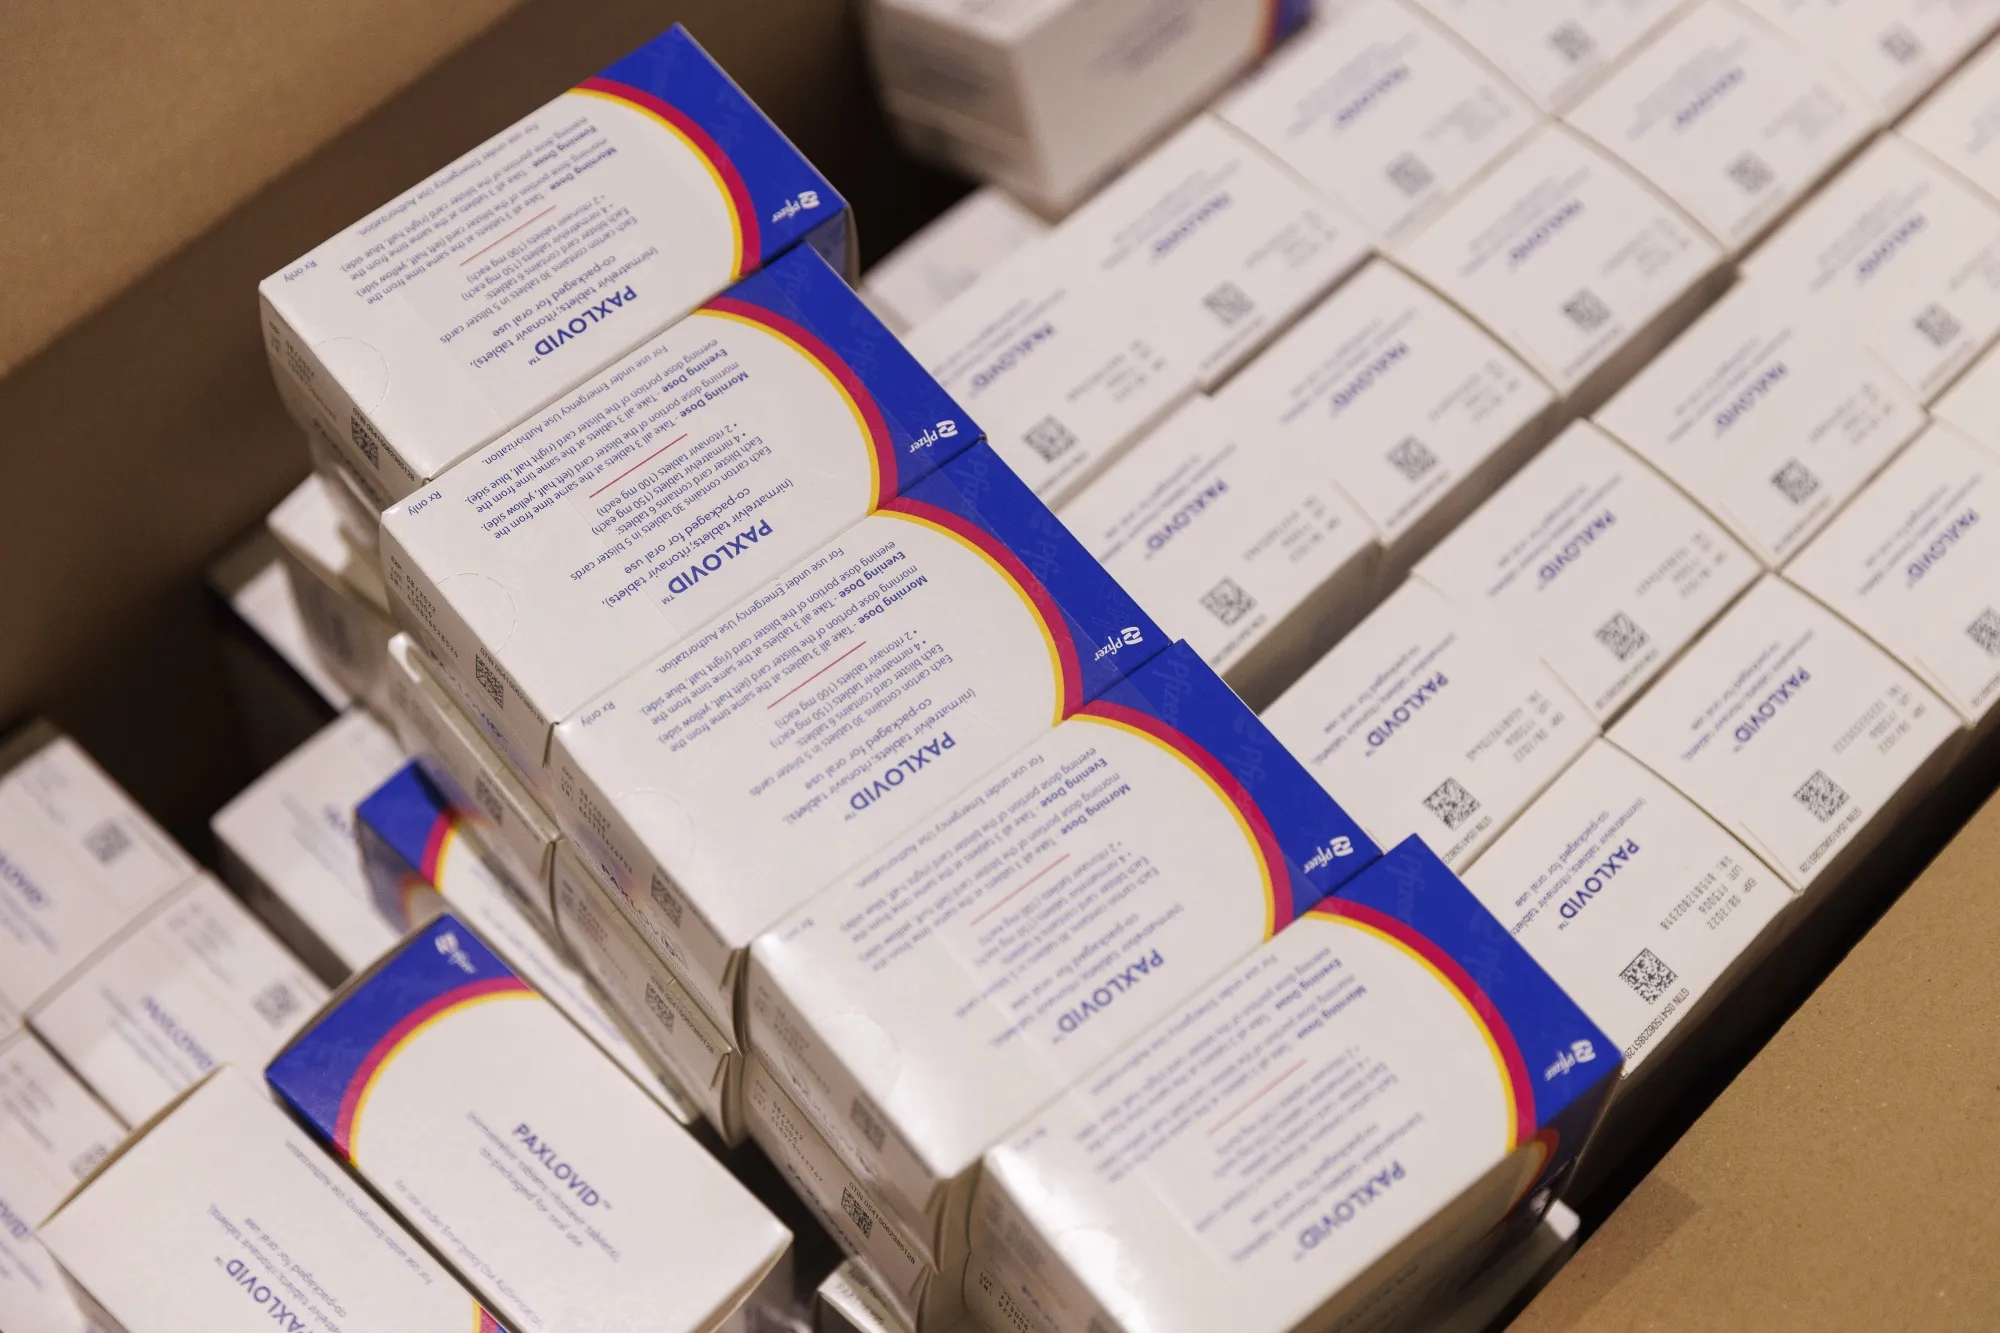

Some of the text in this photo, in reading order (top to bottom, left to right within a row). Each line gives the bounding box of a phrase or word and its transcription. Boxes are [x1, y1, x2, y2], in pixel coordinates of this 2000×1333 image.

[771, 199, 803, 222] Pfizer
[283, 259, 317, 282] Rx only
[491, 255, 616, 336] co-packaged for oral use
[469, 339, 514, 368] tablets),
[464, 339, 717, 504] evening dose portion of the blister card (right half, blue side).
[481, 344, 668, 464] For use under Emergency Use Authorization.
[475, 348, 727, 512] Evening Dose Take all 3 tablets at the same time from the
[480, 361, 739, 531] morning dose portion of the blister card (left half, yellow side).
[909, 428, 938, 452] Pfizer
[493, 370, 748, 538] Morning Dose Take all 3 tablets at the same time from the
[595, 424, 732, 516] 2 ritonavir tablets (100 mg each)
[407, 490, 441, 515] Rx only
[591, 435, 740, 535] 4 nirmatrelvir tablets (150 mg each)
[614, 435, 762, 534] Each blister card contains 6 tablets:
[731, 477, 793, 522] (nirmatrelvir
[569, 445, 771, 580] Each carton contains 30 tablets in 5 blister cards
[623, 487, 750, 573] co-packaged for oral use
[647, 545, 691, 578] ritonavir
[837, 550, 905, 597] Evening Dose
[601, 576, 646, 607] tablets),
[856, 574, 927, 623] Morning Dose
[1094, 636, 1123, 660] Pfizer
[580, 709, 601, 727] only
[1039, 757, 1107, 807] Evening Dose
[1059, 782, 1131, 835] Morning Dose
[1303, 846, 1336, 873] Pfizer
[1547, 862, 1563, 875] for
[1514, 891, 1531, 907] use
[1529, 874, 1547, 894] oral
[1671, 987, 1689, 1006] GTIN
[213, 1255, 306, 1332] AXLOVID™
